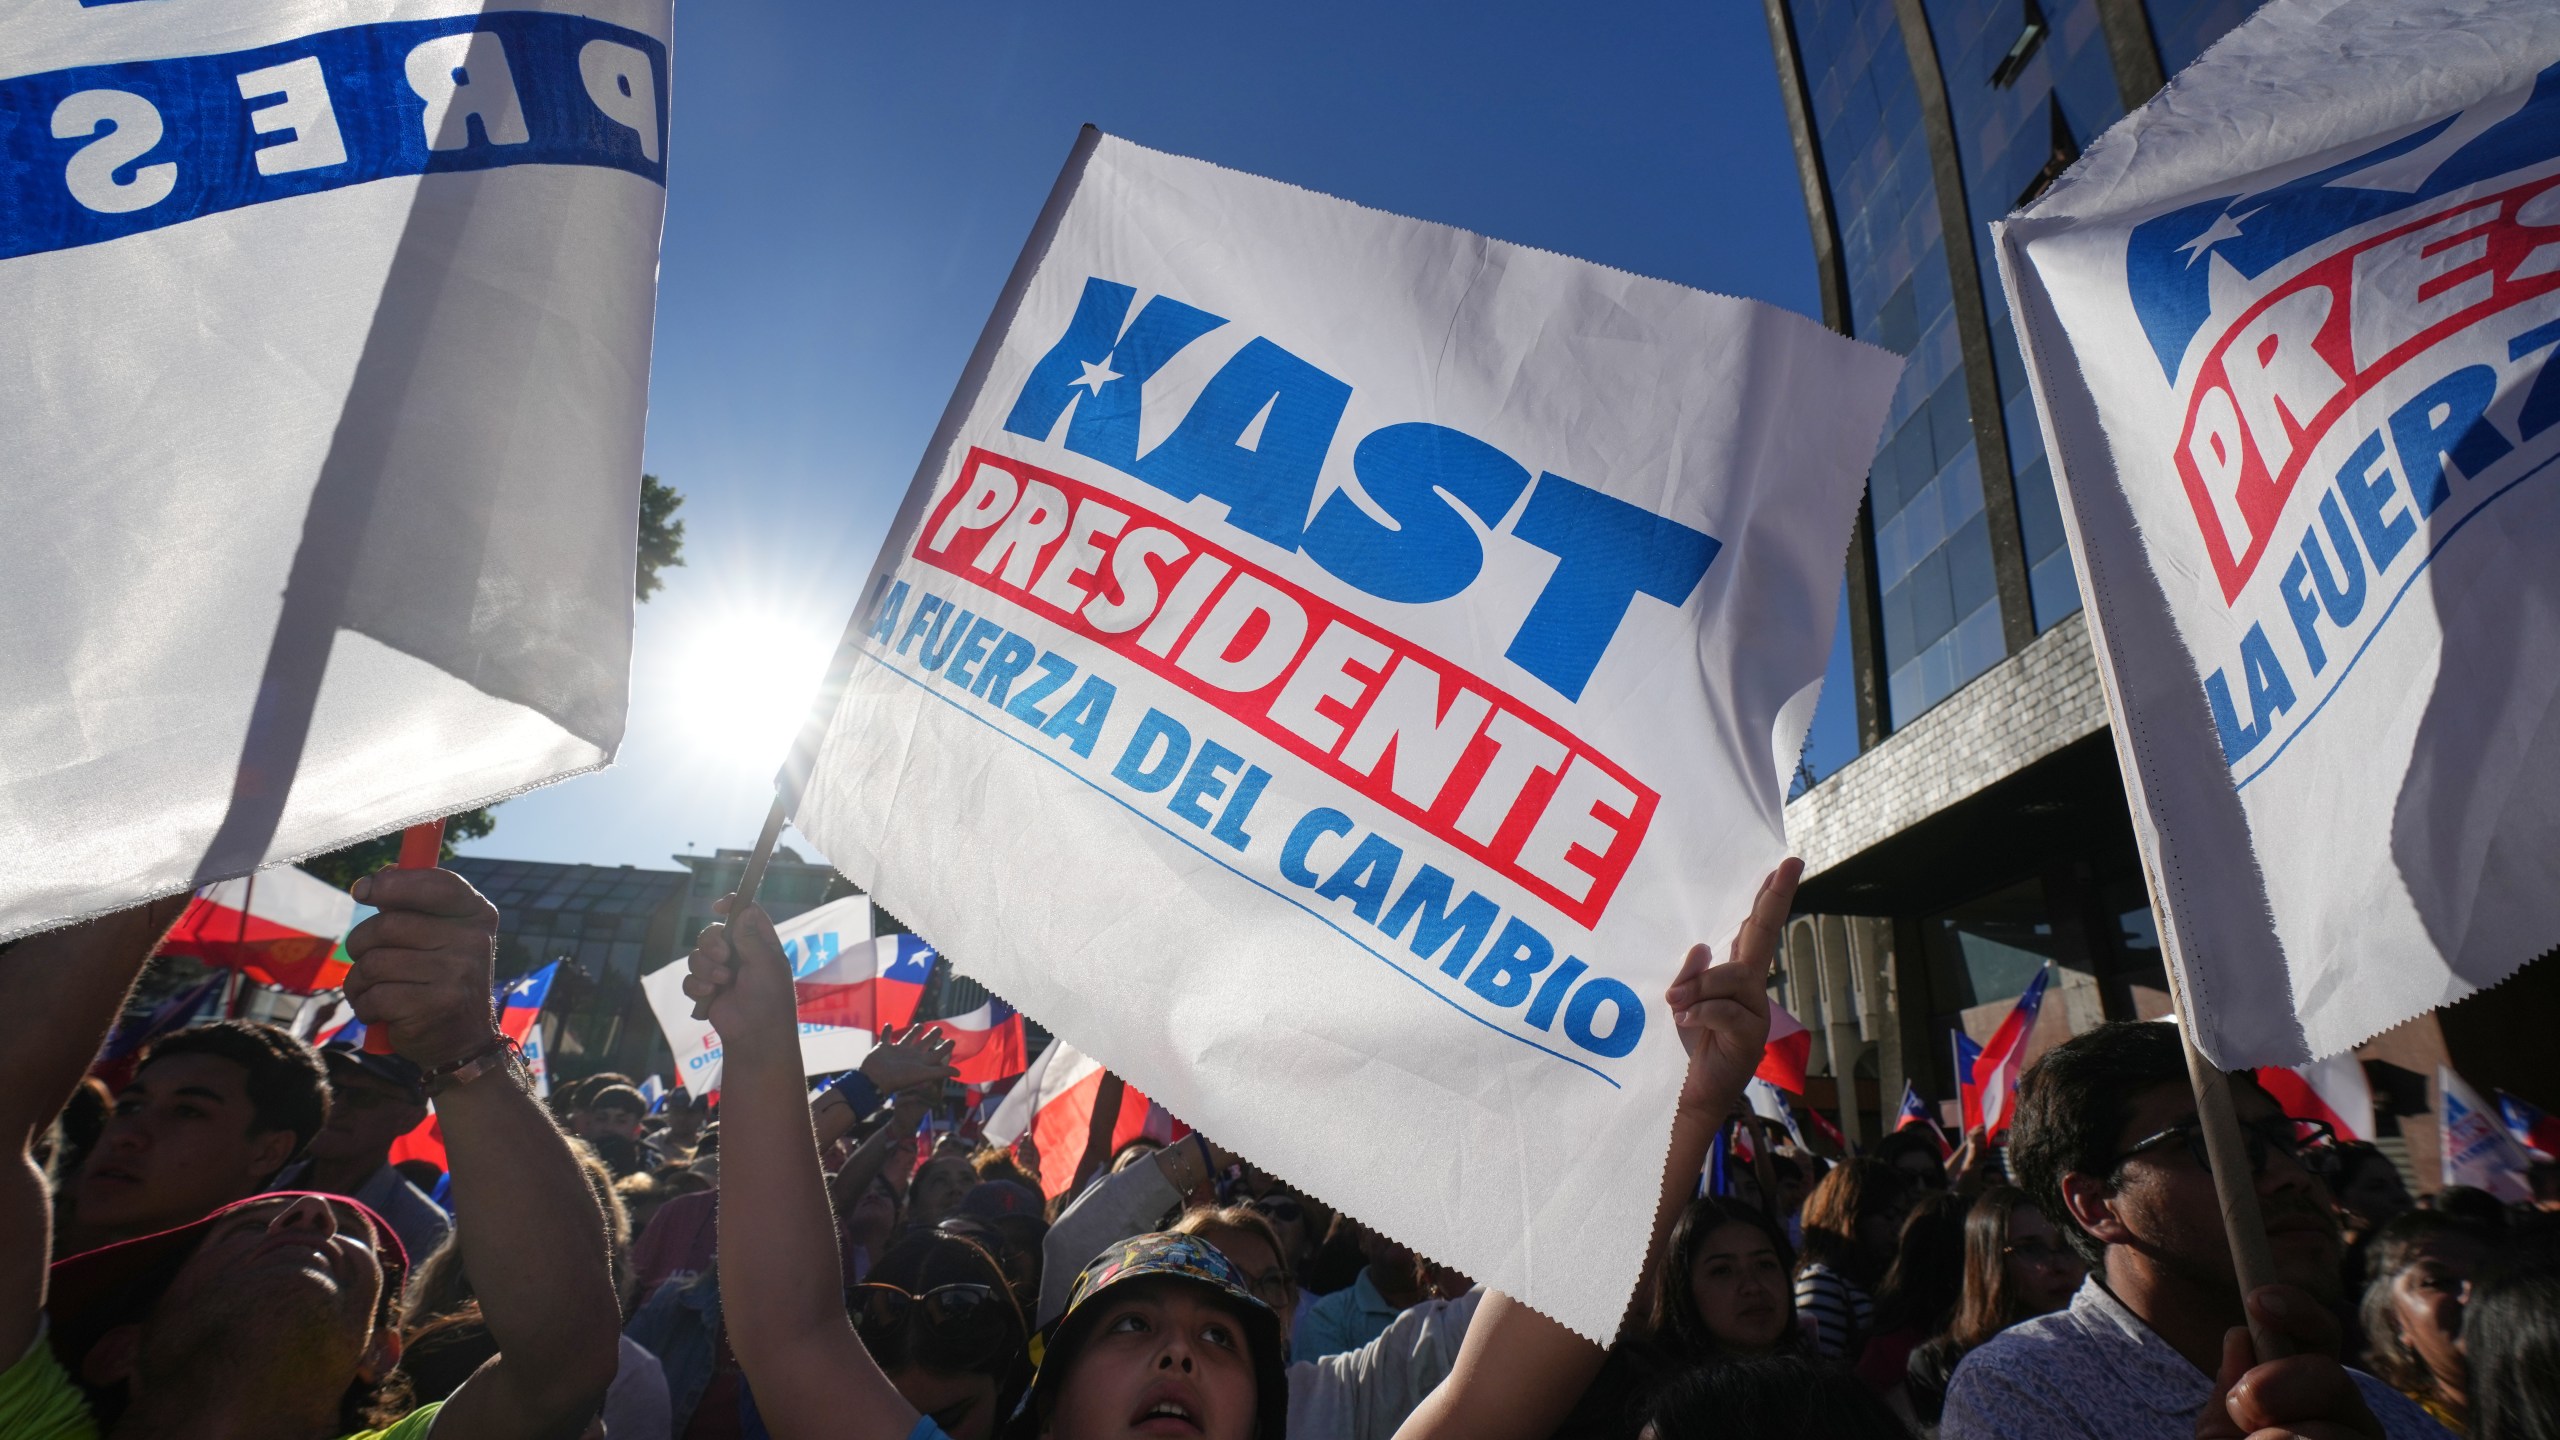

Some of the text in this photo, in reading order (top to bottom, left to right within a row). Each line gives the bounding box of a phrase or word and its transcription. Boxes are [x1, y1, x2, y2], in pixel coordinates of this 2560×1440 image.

[928, 462, 1639, 905] PRESIDENTE
[1002, 276, 1723, 704] KAST
[2203, 620, 2298, 768] LA
[857, 573, 1646, 1059] LA FUERZA DEL CAMBIO
